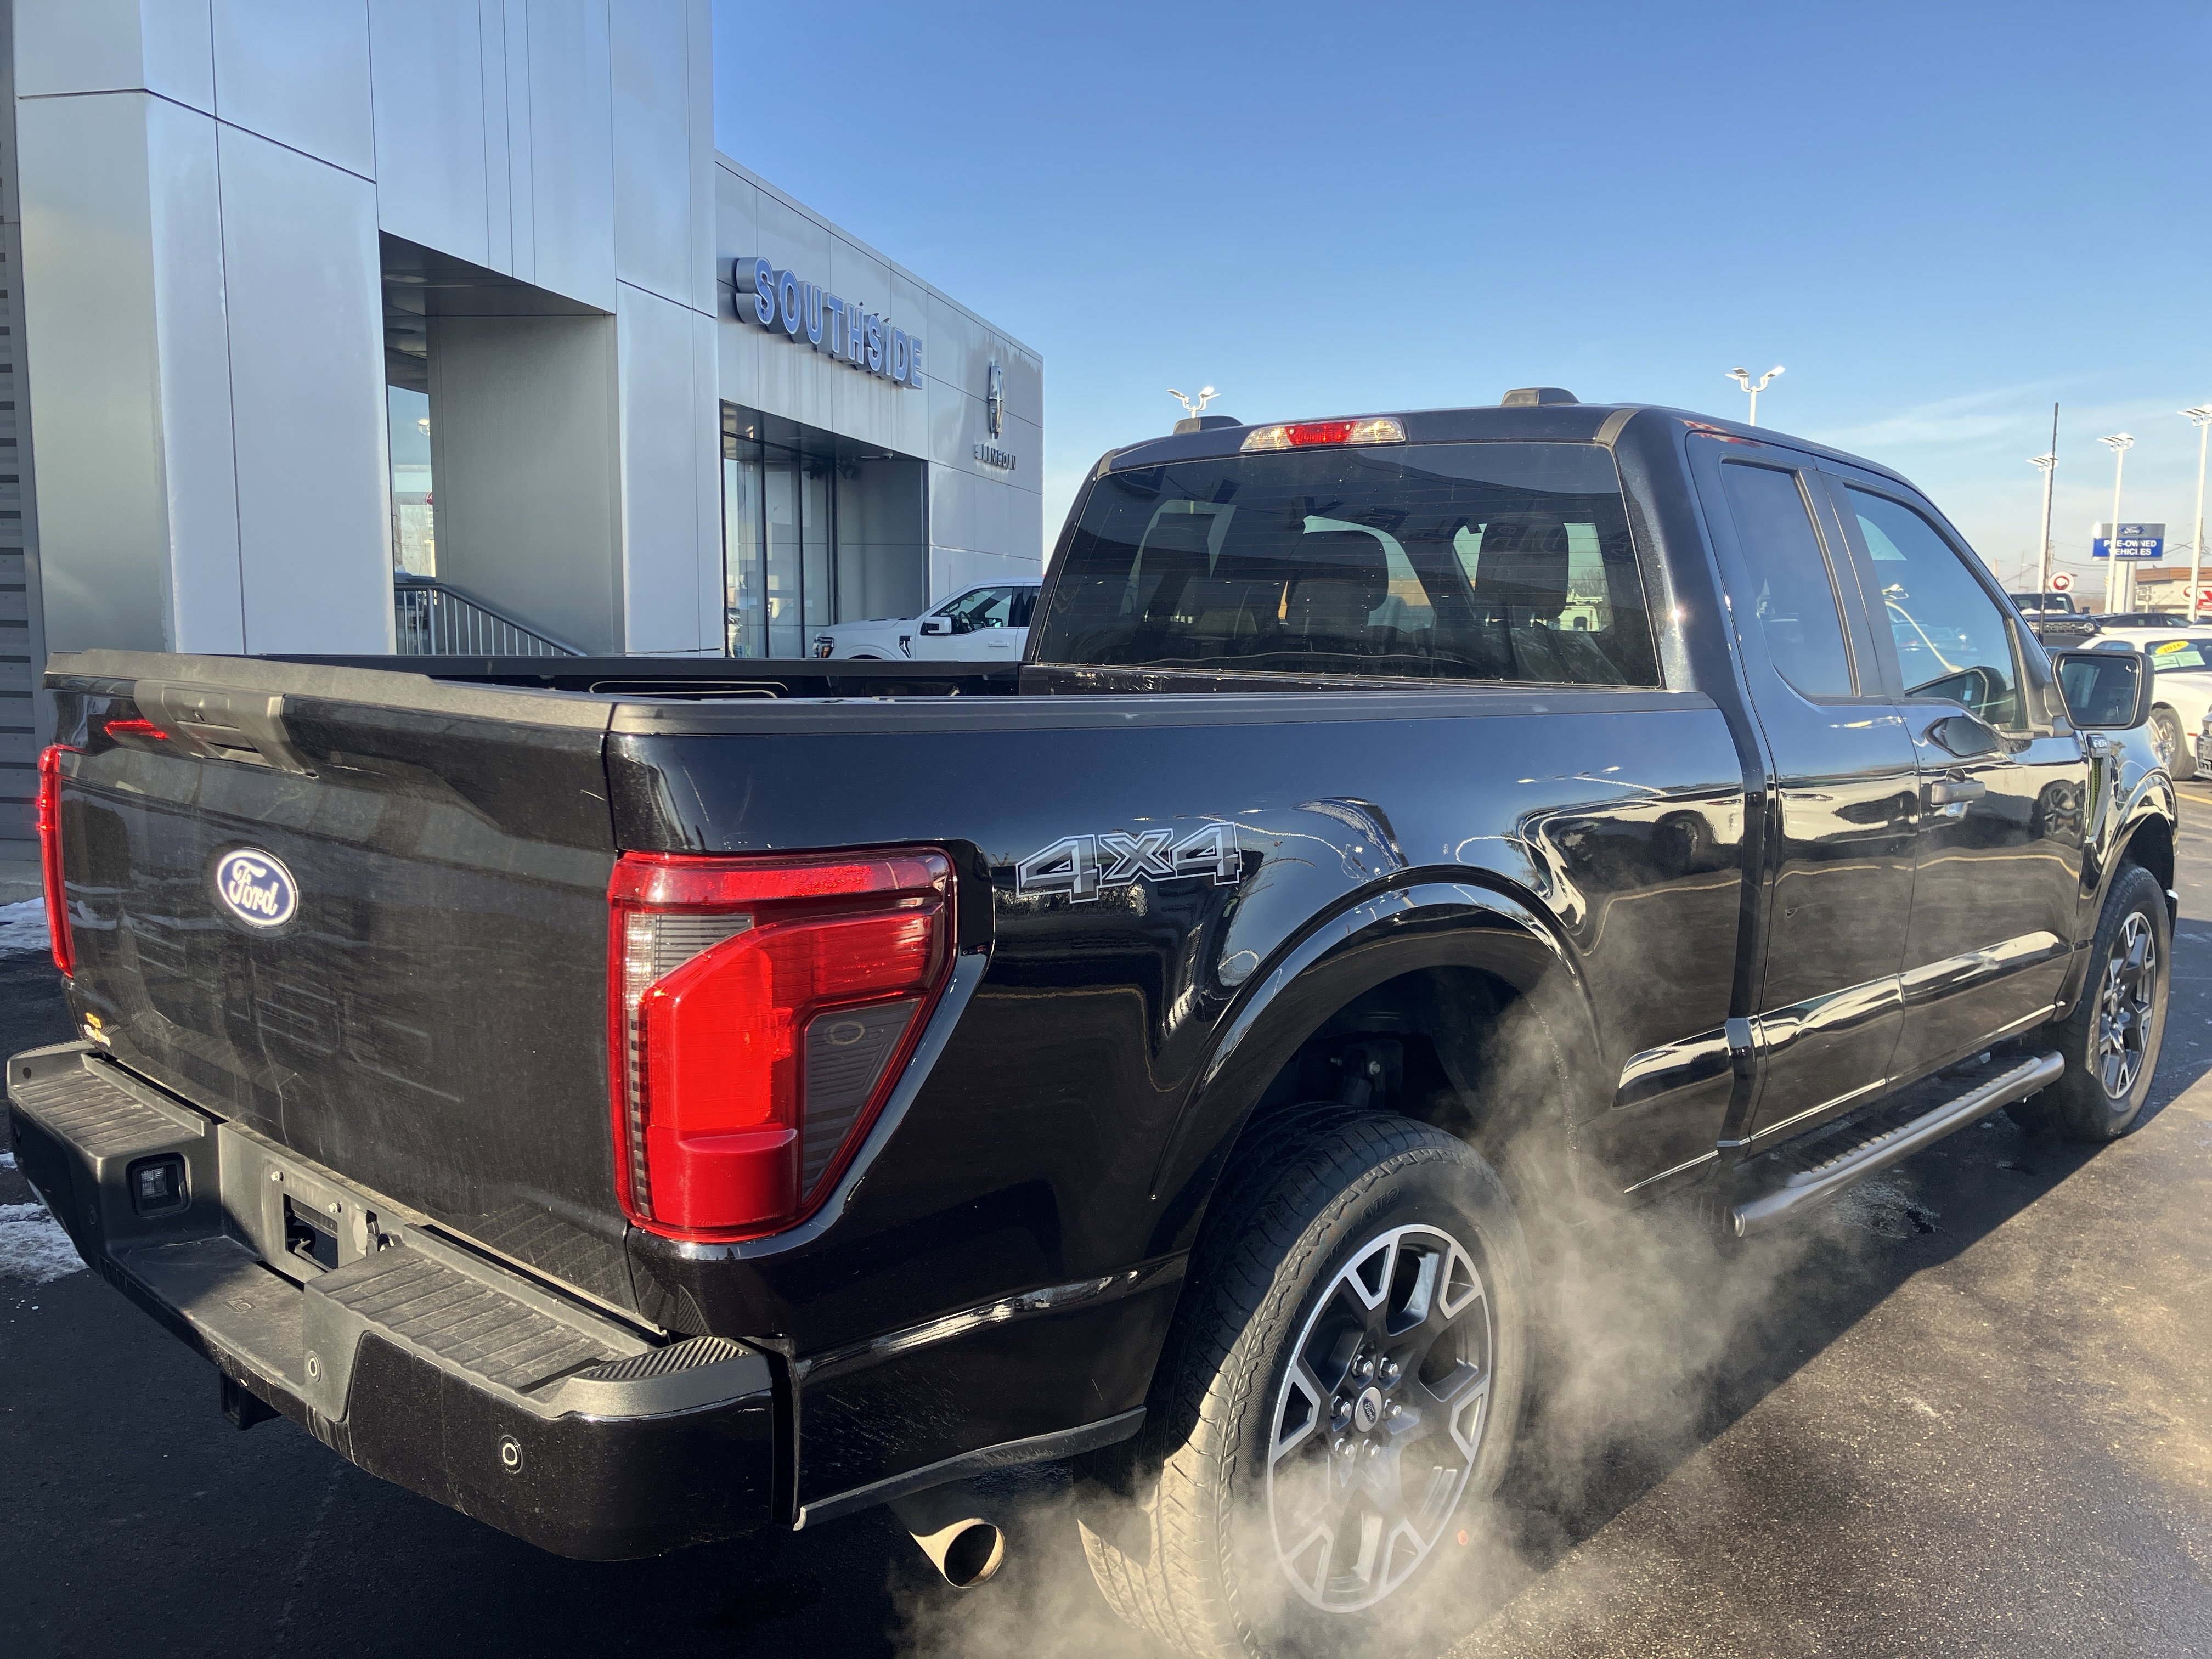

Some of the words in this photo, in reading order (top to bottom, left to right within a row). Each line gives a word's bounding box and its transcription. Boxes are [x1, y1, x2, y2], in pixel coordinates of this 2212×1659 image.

[736, 257, 922, 389] SOUTHSIDE
[228, 859, 279, 916] Ford
[1364, 1402, 1375, 1422] Ford
